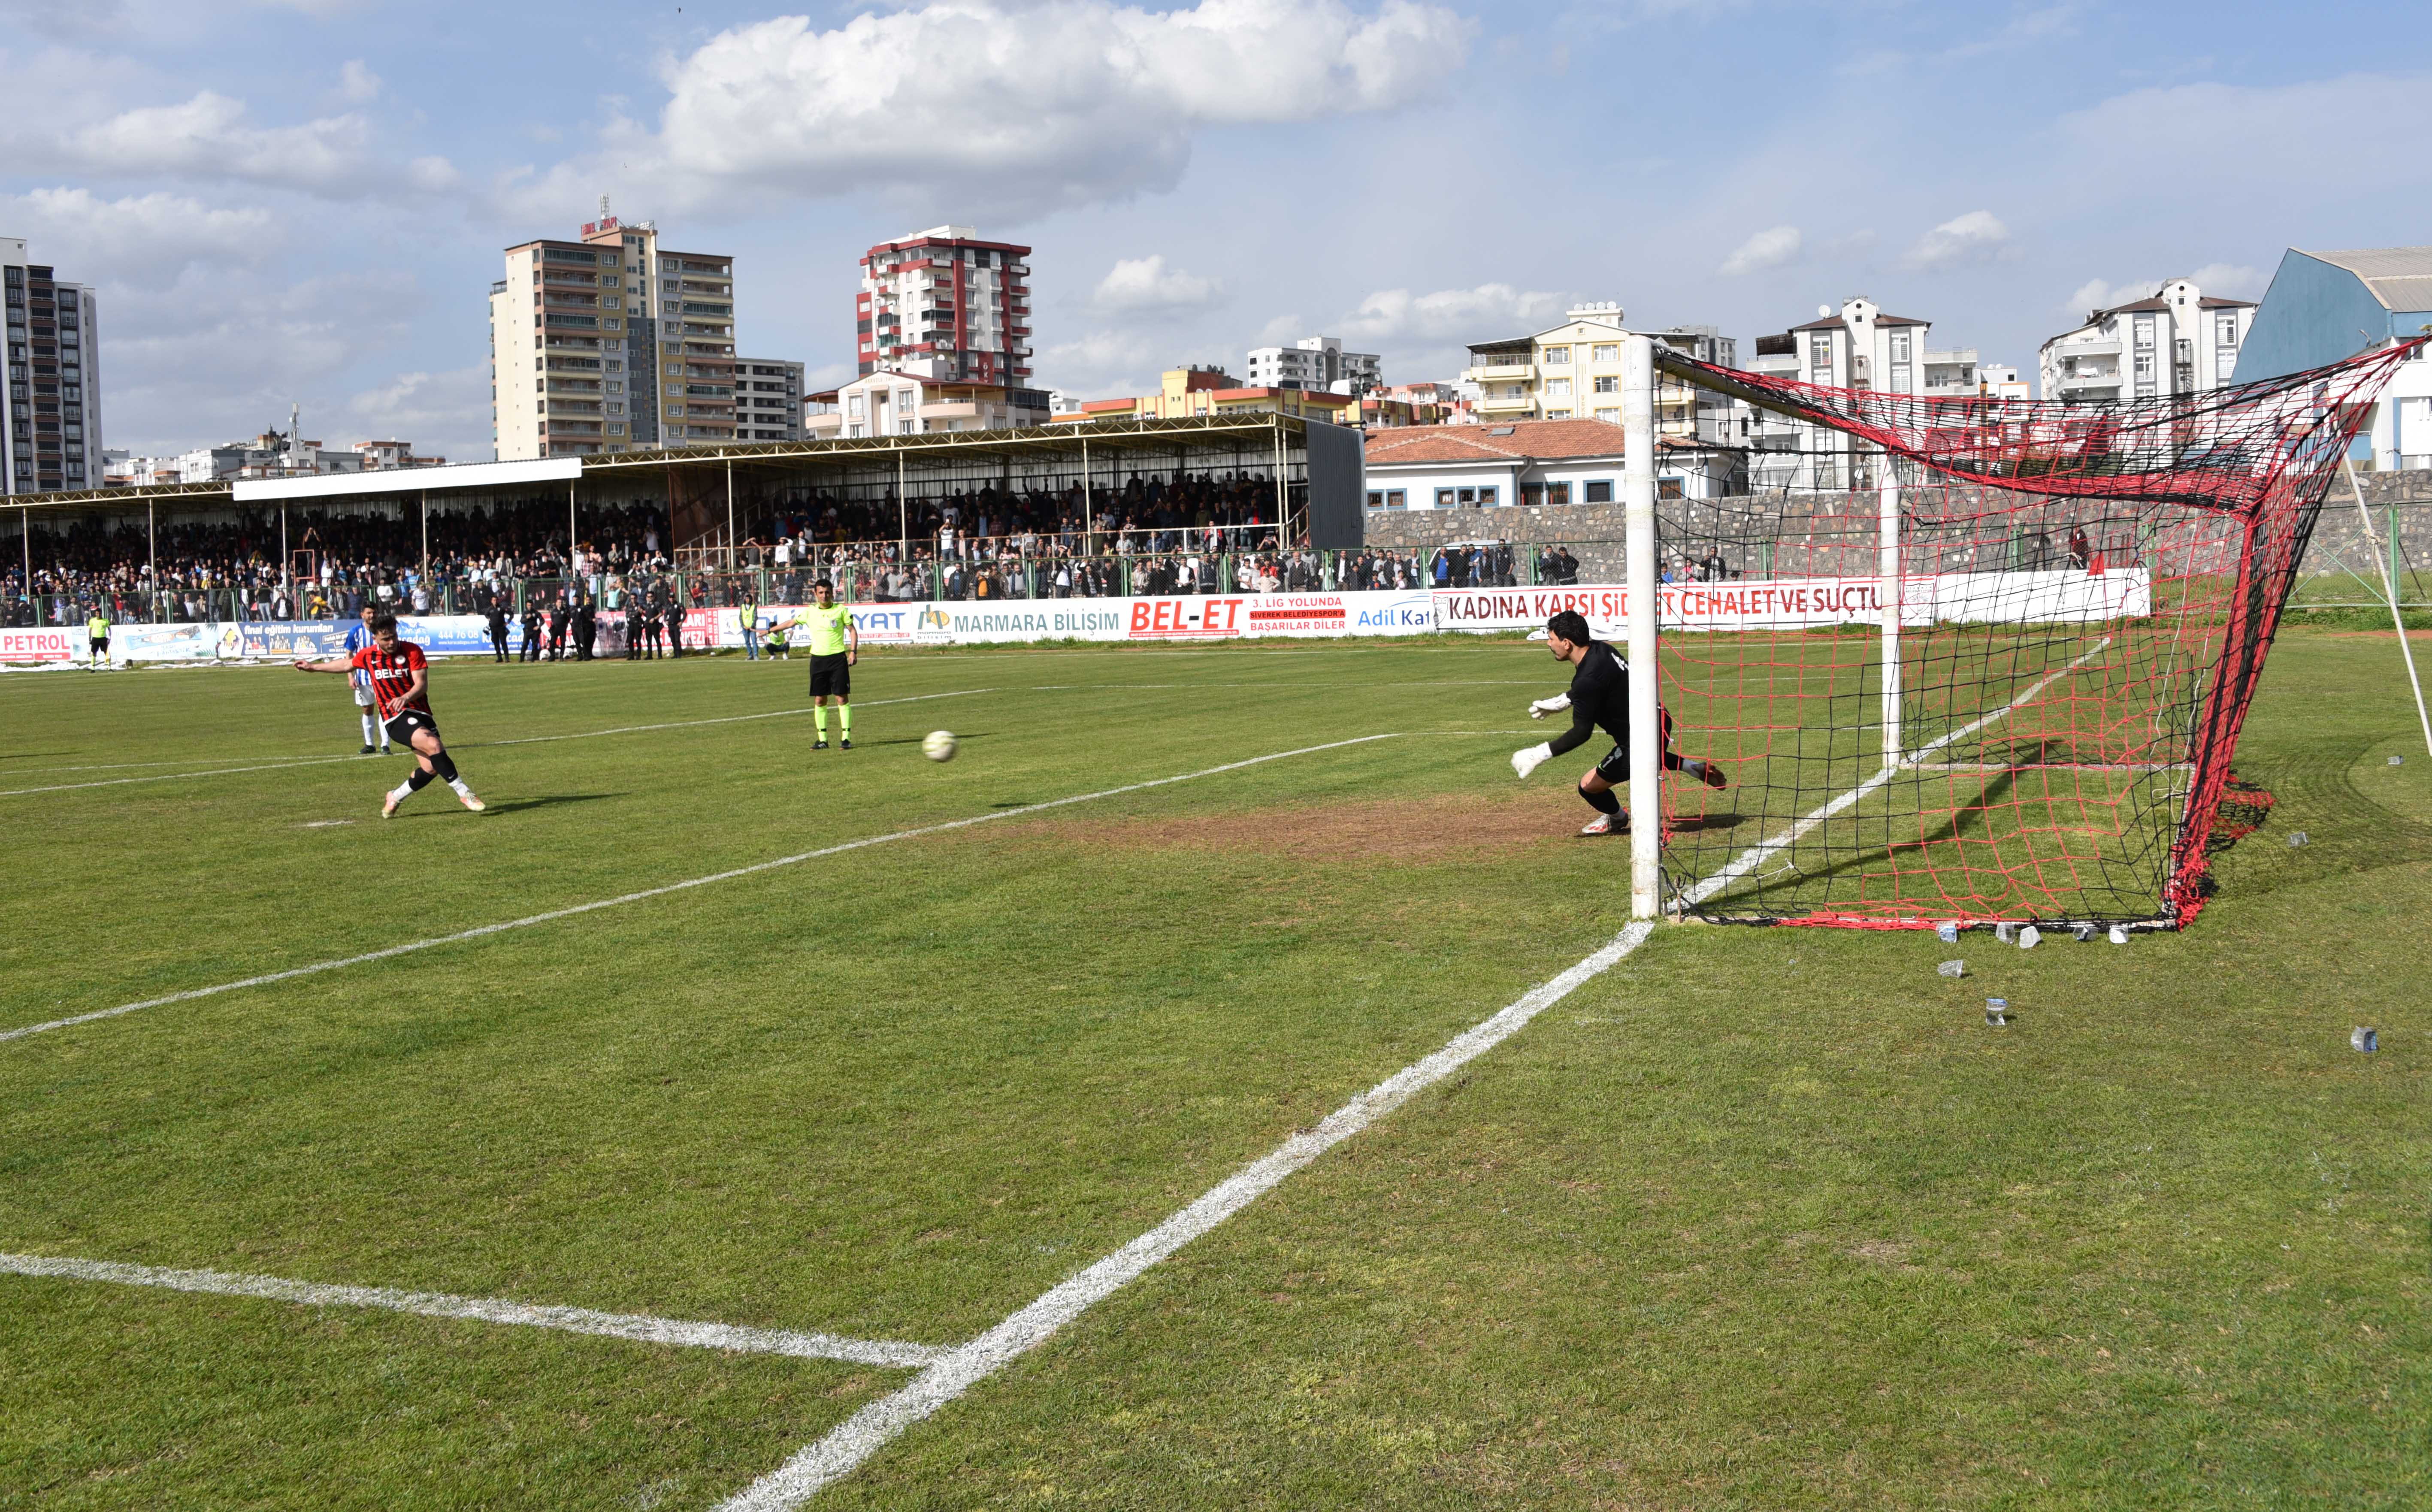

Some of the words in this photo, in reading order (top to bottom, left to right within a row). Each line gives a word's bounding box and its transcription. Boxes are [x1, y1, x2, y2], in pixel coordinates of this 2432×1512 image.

[1252, 599, 1261, 608] 3.
[1266, 597, 1284, 608] LİG
[1288, 597, 1342, 607] YOLUNDA
[1449, 596, 1528, 620] KADINA
[1681, 590, 1775, 616] CEHALET
[1779, 589, 1806, 613] VE
[1813, 587, 1882, 618] SUÇTU
[852, 612, 907, 630] YAT
[955, 614, 1048, 632] MARMARA
[1054, 608, 1119, 635] BİLİŞİM
[1130, 599, 1243, 631] BEL-ET
[1283, 610, 1345, 618] BELEDİYESPOR'A
[1358, 609, 1395, 626] Adil
[244, 625, 263, 635] final
[264, 625, 291, 636] eğitim
[1250, 622, 1310, 632] BAŞARILAR
[1314, 619, 1345, 629] DİLER
[438, 631, 453, 639] 444
[456, 630, 466, 639] 76
[4, 634, 70, 651] PETROL
[375, 668, 409, 680] BELET
